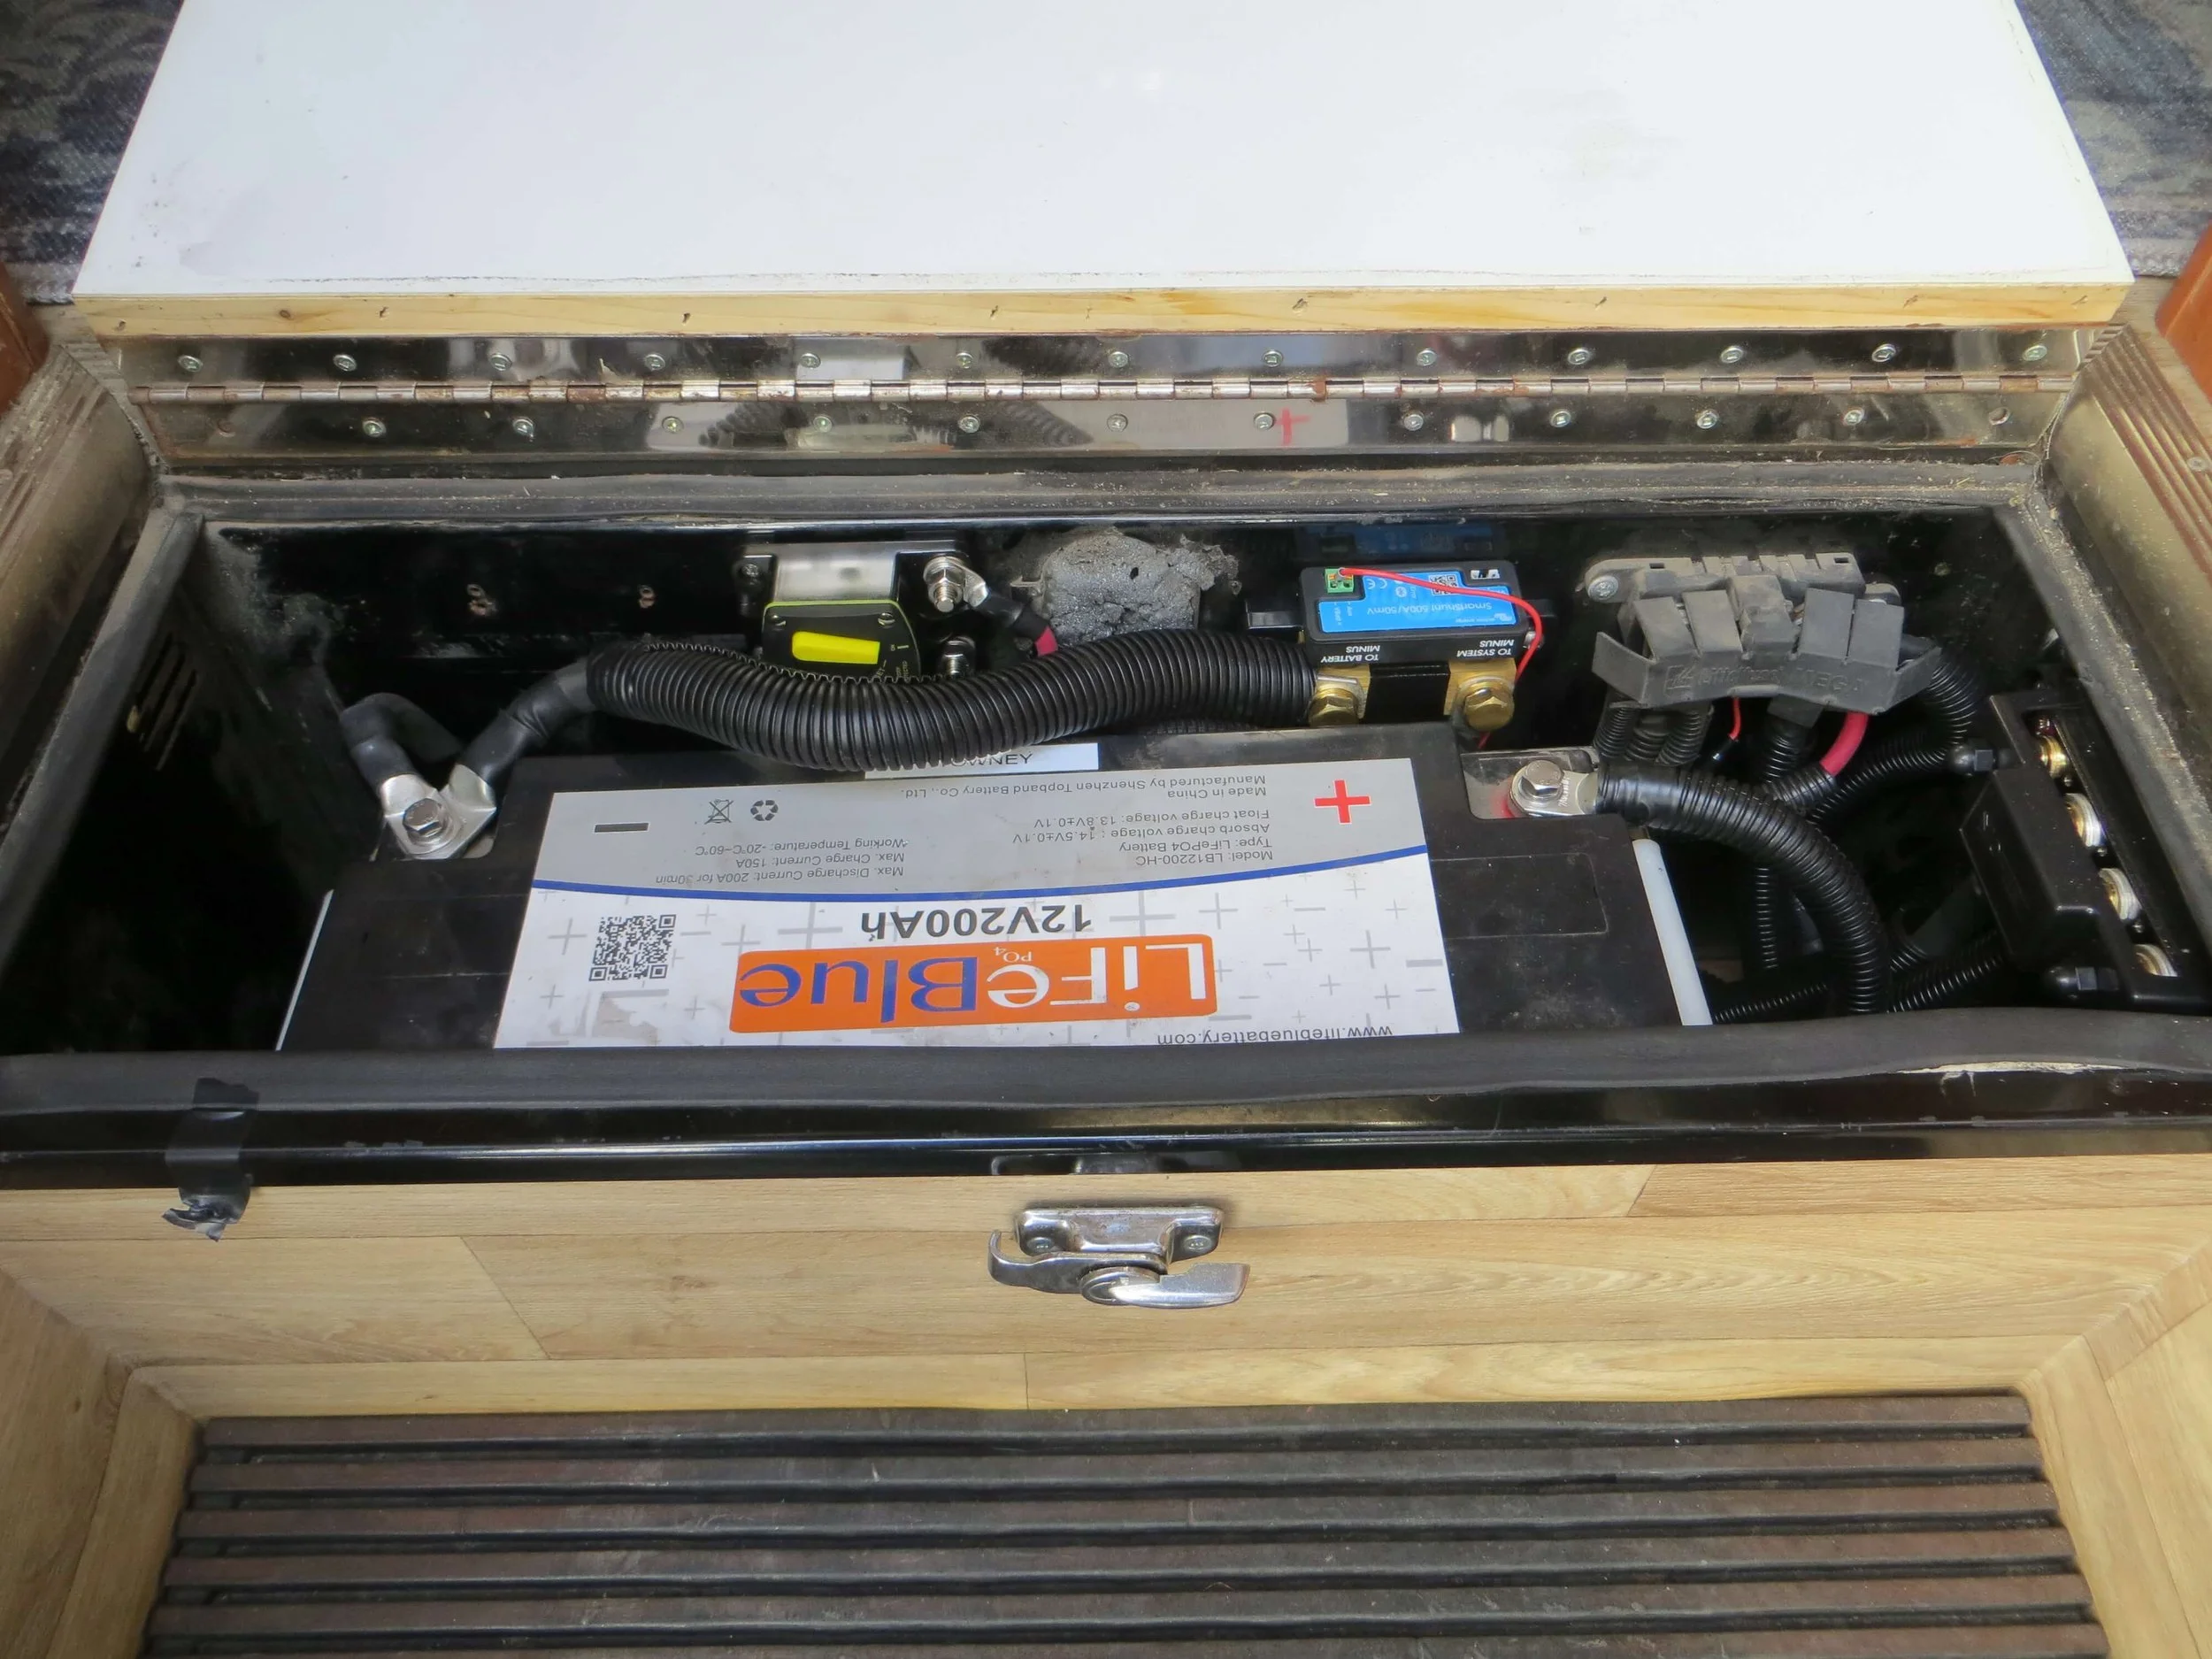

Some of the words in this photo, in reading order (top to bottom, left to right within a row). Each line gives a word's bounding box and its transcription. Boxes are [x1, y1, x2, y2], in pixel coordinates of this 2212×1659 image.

[1479, 639, 1515, 648] MINUS
[1456, 649, 1496, 658] SYSTEM
[1320, 655, 1363, 664] BATTERY
[1076, 780, 1147, 792] Shenzhen
[1149, 778, 1166, 788] by
[1170, 775, 1266, 787] Manufactured
[901, 788, 926, 799] Ltd.
[931, 787, 959, 797] Co.,
[963, 785, 1009, 795] Battery
[1013, 782, 1072, 795] Topband
[1168, 788, 1208, 799] China
[1212, 788, 1225, 797] in
[1228, 787, 1267, 797] Made
[1122, 812, 1178, 824] voltage:
[1181, 810, 1230, 821] charge
[1233, 810, 1270, 819] Float
[1167, 825, 1216, 835] charge
[1219, 824, 1271, 834] Absorb
[770, 839, 851, 851] Temperature:
[855, 838, 907, 849] Working
[1119, 842, 1166, 853] Battery
[1172, 840, 1231, 851] LiFePO4
[1235, 836, 1272, 848] Type:
[772, 855, 821, 866] Current:
[826, 853, 871, 864] Charge
[875, 852, 904, 863] Max.
[1135, 852, 1223, 866] LB12200-HC
[1227, 850, 1273, 862] Model:
[736, 857, 765, 868] 150A
[753, 871, 803, 881] Current:
[807, 867, 870, 879] Discharge
[874, 866, 903, 877] Max.
[696, 873, 713, 884] for
[717, 872, 749, 883] 200A
[860, 904, 1092, 940] 12V200Ah
[740, 942, 1206, 1023] LiFeBlue
